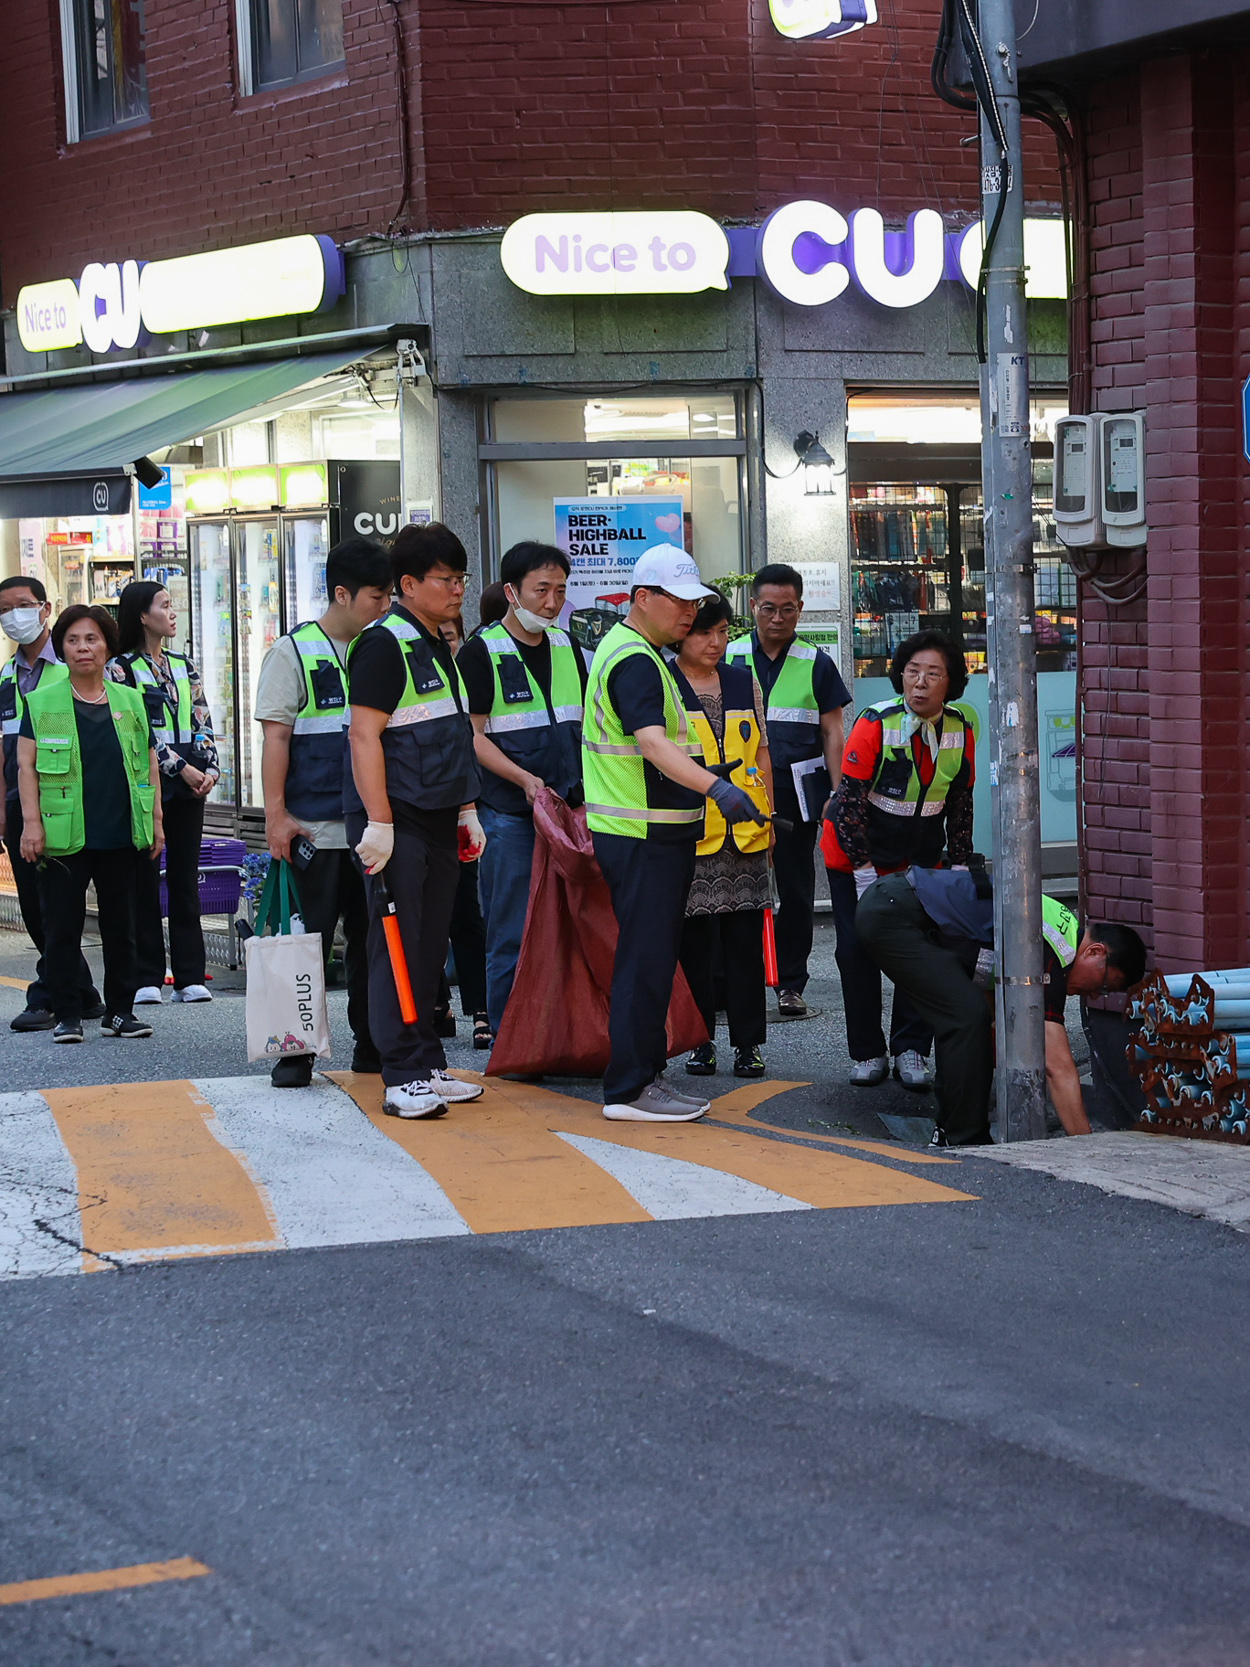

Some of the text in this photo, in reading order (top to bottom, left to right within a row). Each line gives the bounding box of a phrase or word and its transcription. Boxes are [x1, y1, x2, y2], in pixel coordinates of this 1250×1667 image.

[534, 234, 697, 274] Nice to
[761, 200, 944, 308] CU
[24, 302, 67, 333] Nice to
[79, 260, 143, 353] CU
[1011, 356, 1025, 366] KT
[568, 528, 647, 542] HIGHBALL
[569, 543, 609, 556] SALE
[587, 558, 606, 567] 최대
[608, 557, 639, 567] 7,800
[296, 973, 314, 1032] 50PLUS
